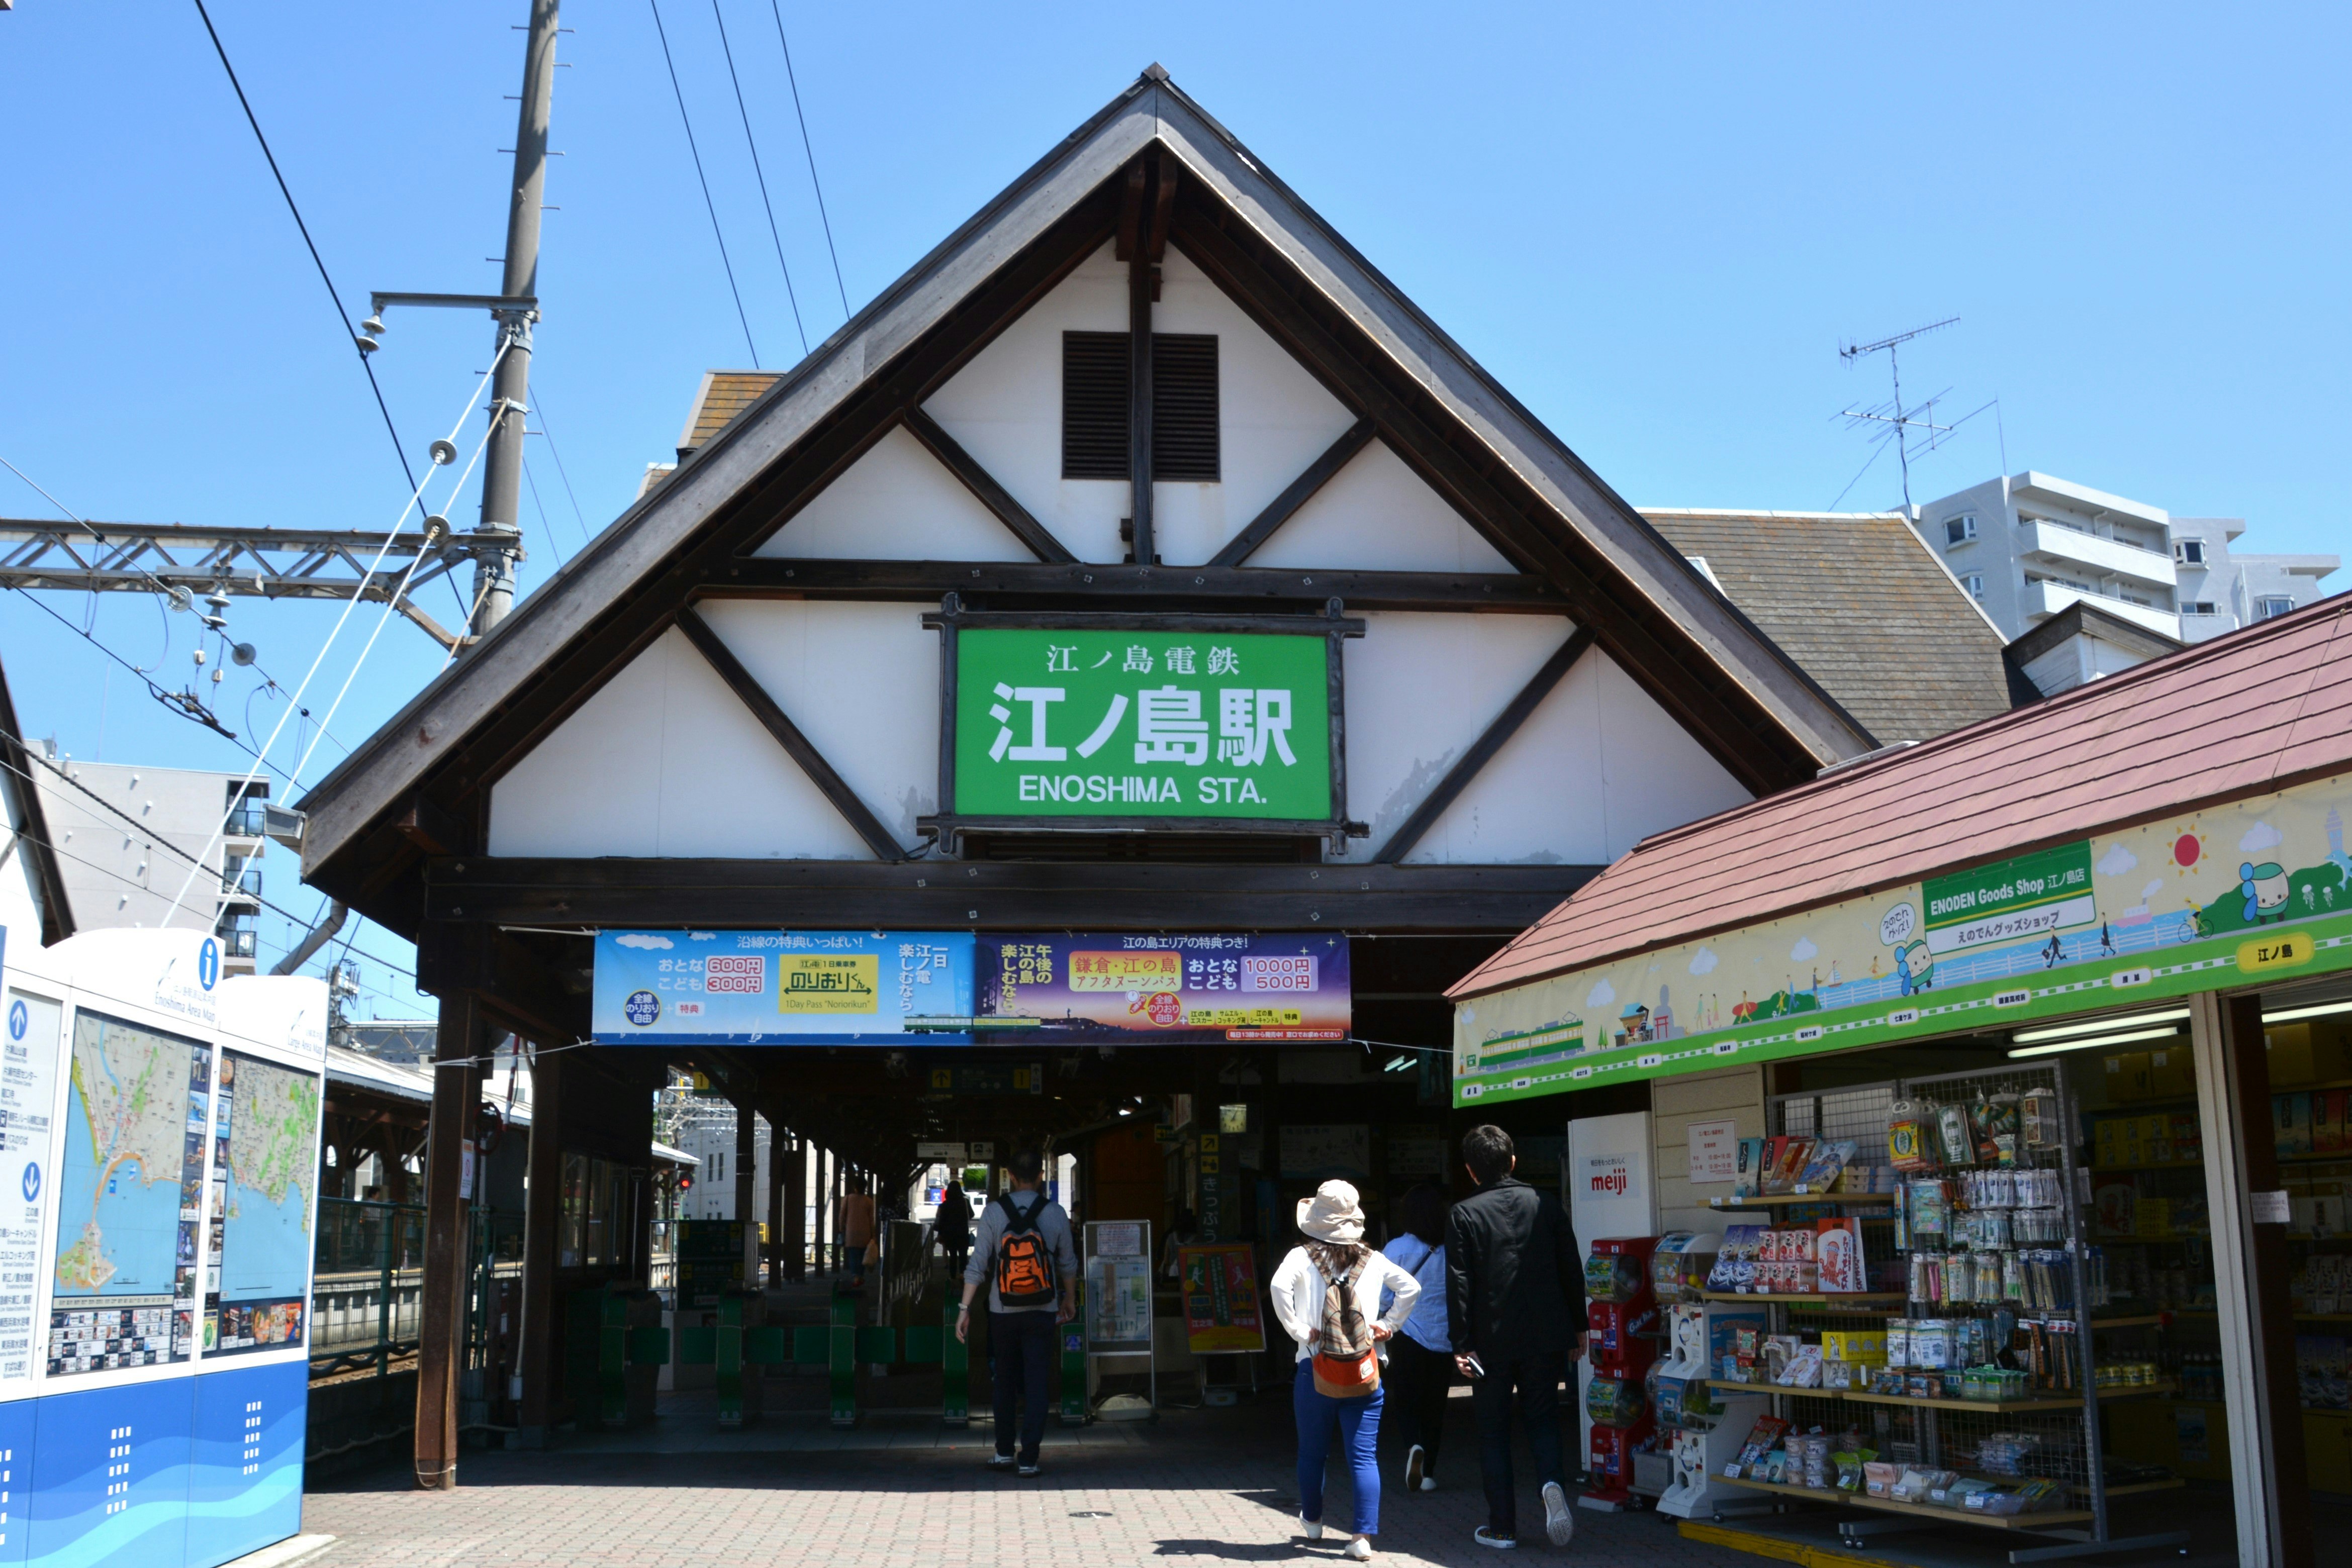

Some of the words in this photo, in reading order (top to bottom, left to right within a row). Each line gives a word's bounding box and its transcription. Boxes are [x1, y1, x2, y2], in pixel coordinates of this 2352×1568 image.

[1047, 644, 1240, 676] 江ノ島電鉄
[988, 681, 1297, 767] 江ノ島駅
[1019, 775, 1181, 803] ENOSHIMA
[1198, 777, 1267, 804] STA.
[1931, 891, 1975, 916] ENODEN
[1978, 885, 2014, 905] Goods
[2017, 876, 2045, 899] Shop
[2047, 867, 2085, 889] 江ノ島店
[1883, 909, 1909, 930] えのでん
[1958, 911, 2060, 944] えのでんグッズショップ
[932, 946, 949, 968] 一日
[2259, 944, 2293, 962] 江ノ島
[658, 958, 704, 973] おとな
[708, 957, 763, 974] 600円
[916, 944, 931, 985] 江ノ電
[1018, 944, 1035, 985] 江の島
[1036, 944, 1053, 985] 午後の
[1188, 959, 1238, 973] おとな
[1245, 957, 1311, 973] 1000円
[658, 977, 703, 991] こども
[707, 975, 763, 993] 300円
[791, 972, 865, 990] のりおりくん
[898, 943, 914, 1011] 楽しむなら
[1000, 944, 1017, 1013] 楽しむなら
[1076, 975, 1177, 989] アフタヌーンパス
[1189, 976, 1237, 990] こども
[1256, 975, 1311, 990] 500円
[633, 993, 653, 1004] 全線
[786, 1001, 803, 1009] 1Day
[806, 1000, 822, 1008] Pass
[1155, 996, 1174, 1005] 全線
[155, 992, 185, 1013] Enoshima
[188, 1003, 201, 1018] Area
[203, 1008, 215, 1026] Map
[625, 1003, 660, 1014] のりおり
[679, 1004, 699, 1015] 特典
[1148, 1005, 1179, 1014] のりおり
[633, 1013, 652, 1024] 自由
[1156, 1014, 1173, 1023] 自由
[288, 1033, 301, 1051] Large
[302, 1040, 312, 1052] Area
[313, 1044, 323, 1057] Map
[1591, 1168, 1627, 1196] meiji
